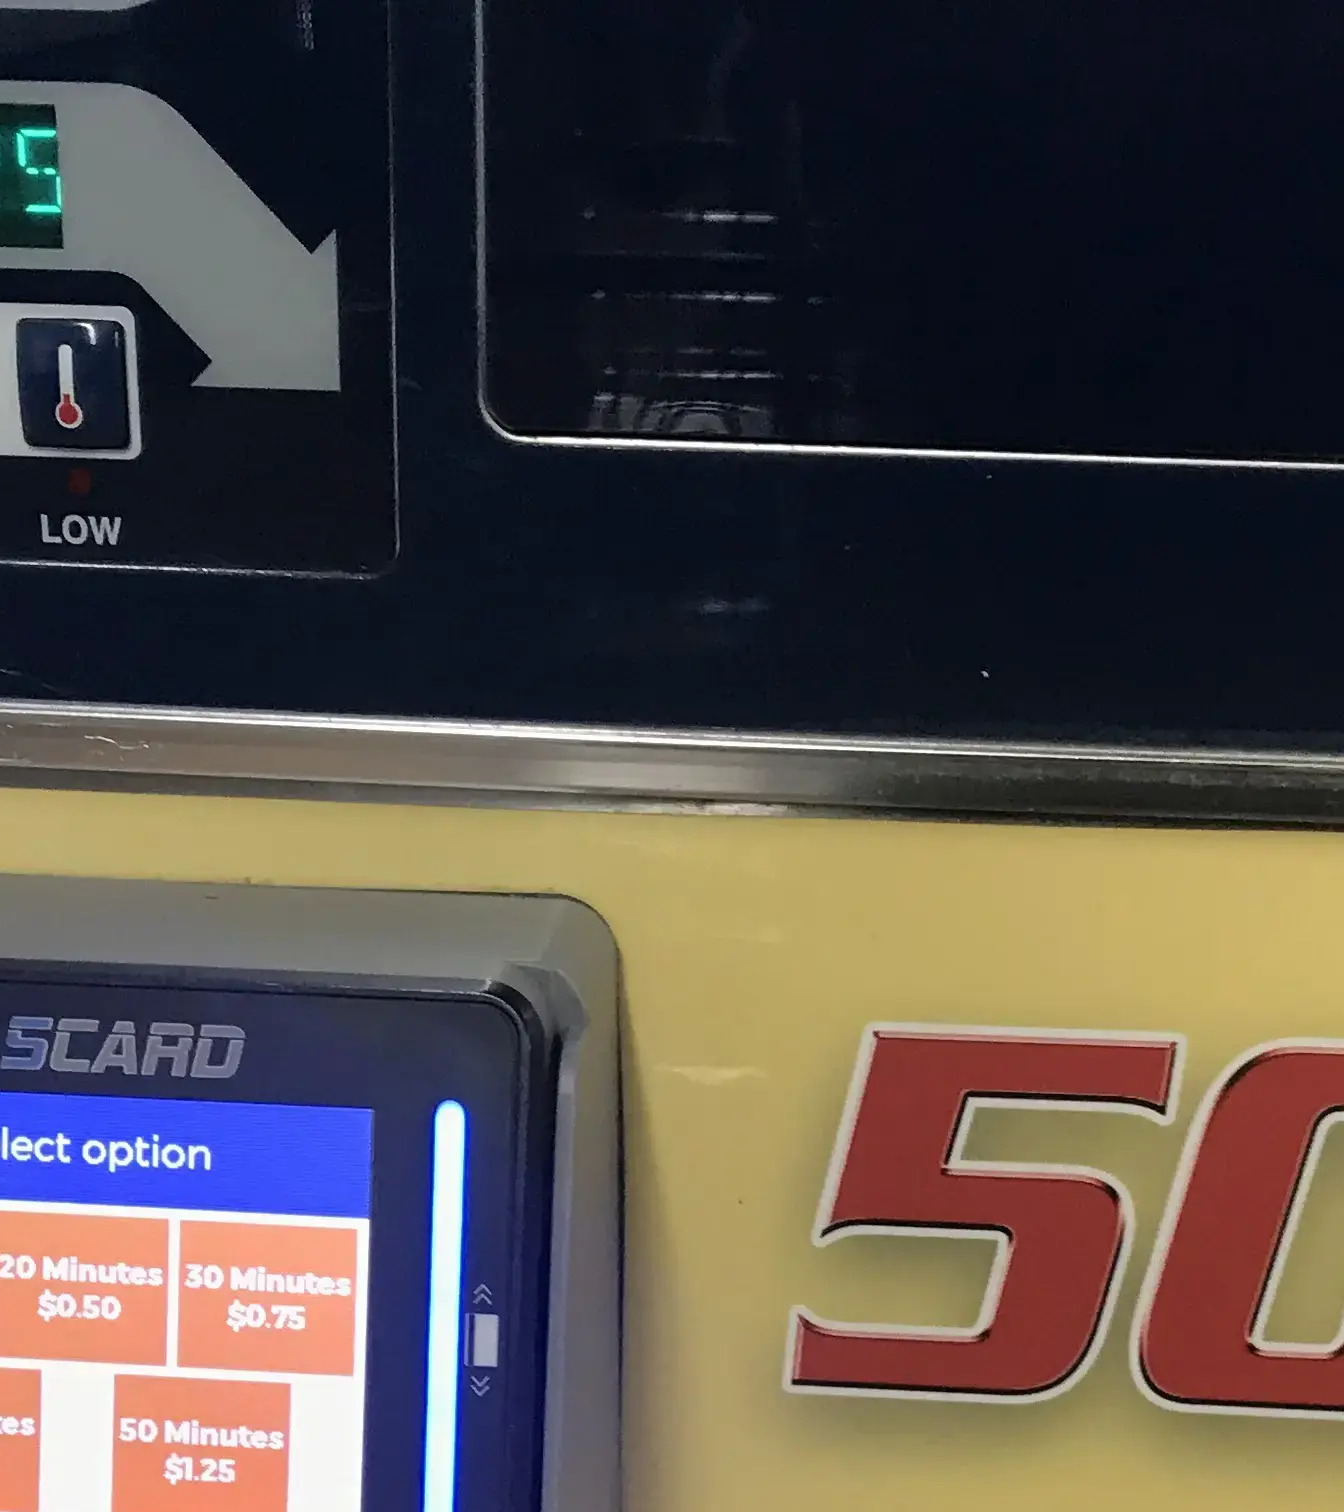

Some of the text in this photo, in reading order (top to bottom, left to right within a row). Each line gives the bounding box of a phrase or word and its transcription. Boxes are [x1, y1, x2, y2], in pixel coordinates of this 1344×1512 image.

[39, 512, 122, 547] LOW
[82, 1132, 213, 1174] option
[41, 1256, 164, 1288] Minutes
[184, 1263, 353, 1298] 30 Minutes
[37, 1291, 122, 1324] $0.50
[226, 1300, 307, 1333] $0.75
[118, 1416, 286, 1453] 50 Minutes
[164, 1453, 237, 1487] $1.25
